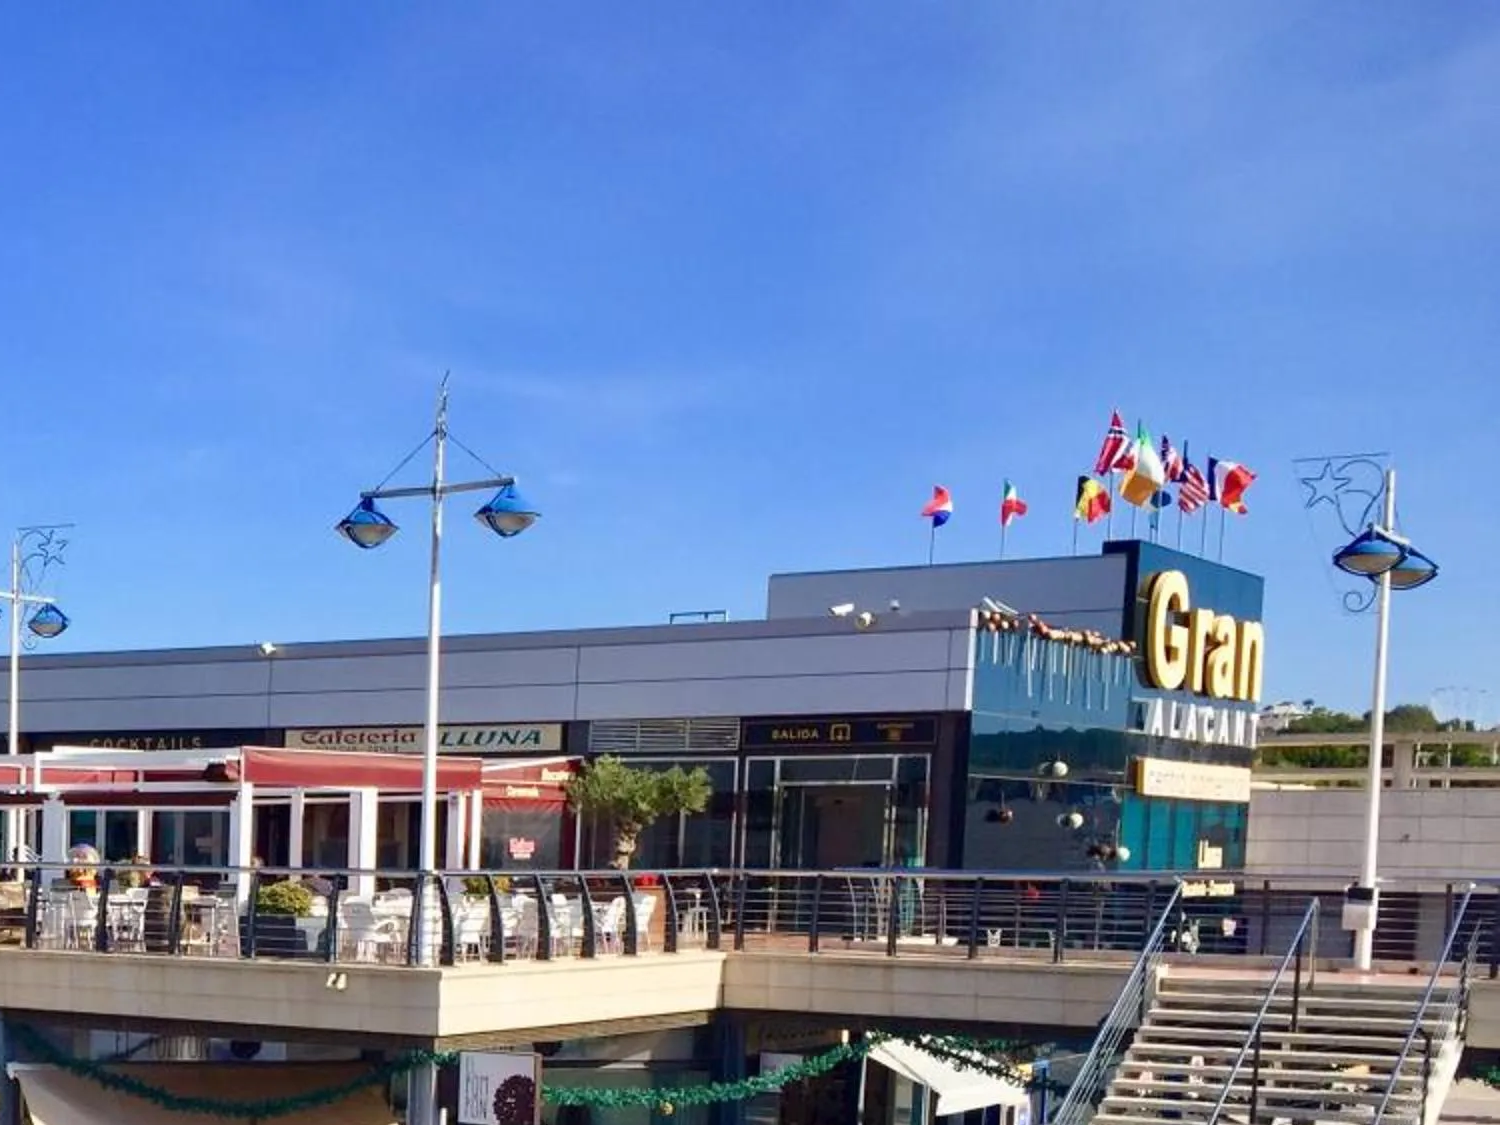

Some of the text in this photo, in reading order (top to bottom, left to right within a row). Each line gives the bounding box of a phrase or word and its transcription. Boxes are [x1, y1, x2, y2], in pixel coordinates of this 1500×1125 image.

[1147, 570, 1264, 702] Gran
[1150, 697, 1260, 749] ALACANT
[89, 736, 202, 750] COCKTAILS
[300, 729, 542, 747] Cafeteria LLUNA
[771, 728, 819, 740] SALIDA
